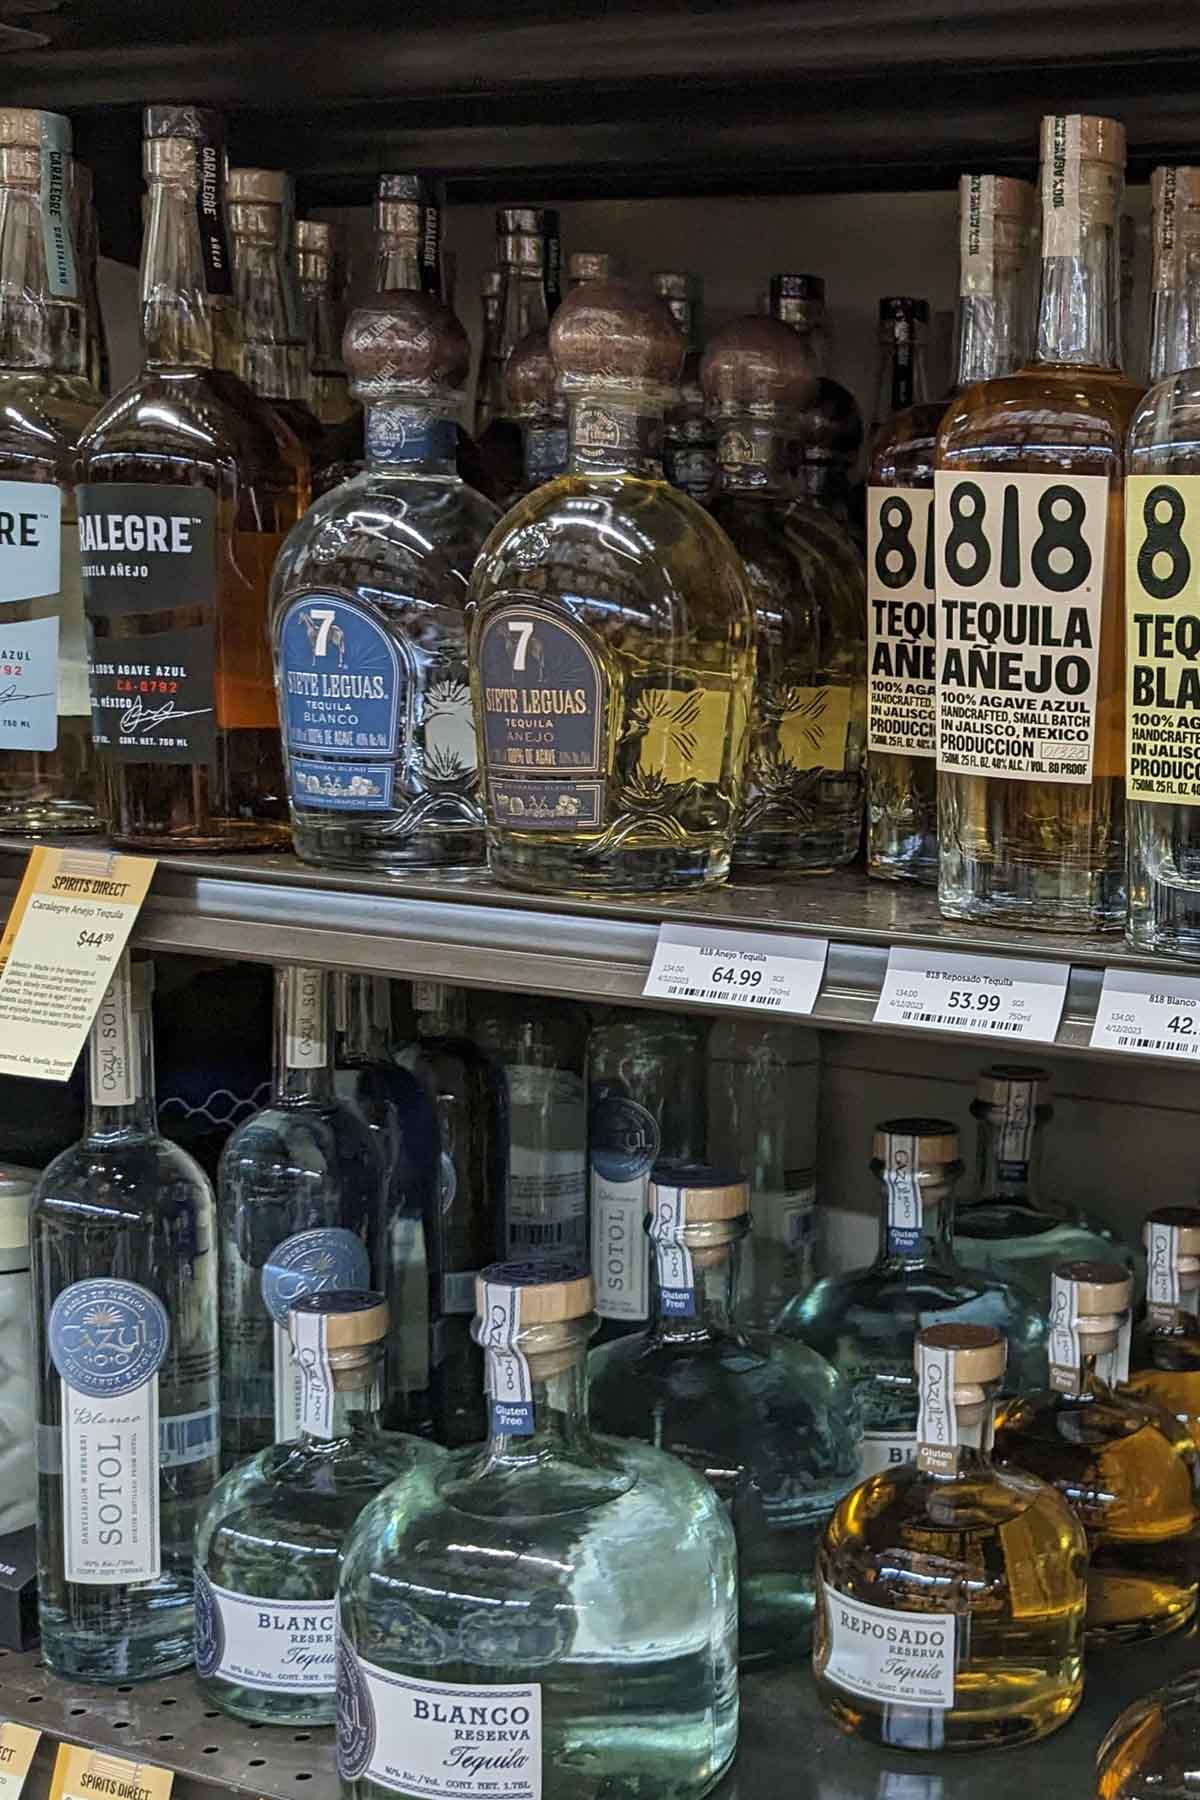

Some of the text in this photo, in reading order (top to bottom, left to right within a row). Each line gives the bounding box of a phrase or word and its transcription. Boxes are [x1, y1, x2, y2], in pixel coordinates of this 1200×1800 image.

[49, 151, 63, 217] CARALEGRE
[203, 146, 217, 217] CARALEGRE
[1052, 178, 1065, 209] 100%
[944, 480, 1093, 593] 818
[310, 609, 336, 657] 7
[941, 599, 1093, 649] TEQUILA
[508, 621, 534, 671] 7
[117, 664, 151, 677] AGAVE
[156, 665, 188, 678] AZUL
[941, 643, 1092, 695] AÑEJO
[871, 681, 903, 693] 100%
[305, 700, 352, 712] TEQUILA
[486, 687, 587, 715] SIETE LEGUAS
[871, 704, 882, 716] IN
[941, 691, 1091, 714] 100% AGAVE AZUL
[303, 711, 359, 726] BLANCO
[505, 717, 554, 729] TEQUILA
[940, 705, 1091, 729] HANDCRAFTED, SMALL BATCH
[1132, 712, 1174, 729] 100%
[941, 719, 1089, 742] IN JALISCO, MEXICO
[940, 733, 1034, 759] PRODUCCION
[1132, 742, 1147, 756] IN
[961, 755, 971, 767] 25
[1049, 761, 1060, 775] 80
[1061, 763, 1089, 776] PROOF
[51, 876, 131, 898] SPIRITS DIRECT
[738, 951, 767, 963] Tequila
[711, 966, 762, 988] 64.99
[941, 971, 982, 985] Reposado
[983, 975, 1014, 988] Tequila
[947, 990, 1000, 1013] 53.99
[1166, 995, 1197, 1008] Blanco
[1167, 1015, 1200, 1036] 42.
[608, 1209, 626, 1291] SOTOL
[661, 1289, 690, 1301] Gluten
[665, 1298, 687, 1310] Free
[73, 1407, 142, 1426] Blanco
[493, 1404, 529, 1418] Gluten
[499, 1415, 524, 1426] Free
[920, 1446, 953, 1460] Gluten
[926, 1457, 948, 1469] Free
[97, 1433, 123, 1546] SOTOL
[258, 1612, 334, 1631] BLANC
[840, 1609, 945, 1647] REPOSADO
[888, 1646, 945, 1659] RESERVA
[879, 1657, 944, 1683] Tequila
[413, 1698, 531, 1726] BLANCO
[454, 1728, 531, 1743] RESERVA
[442, 1745, 529, 1778] Tequila
[80, 1773, 152, 1800] SPIRITS DIRECT
